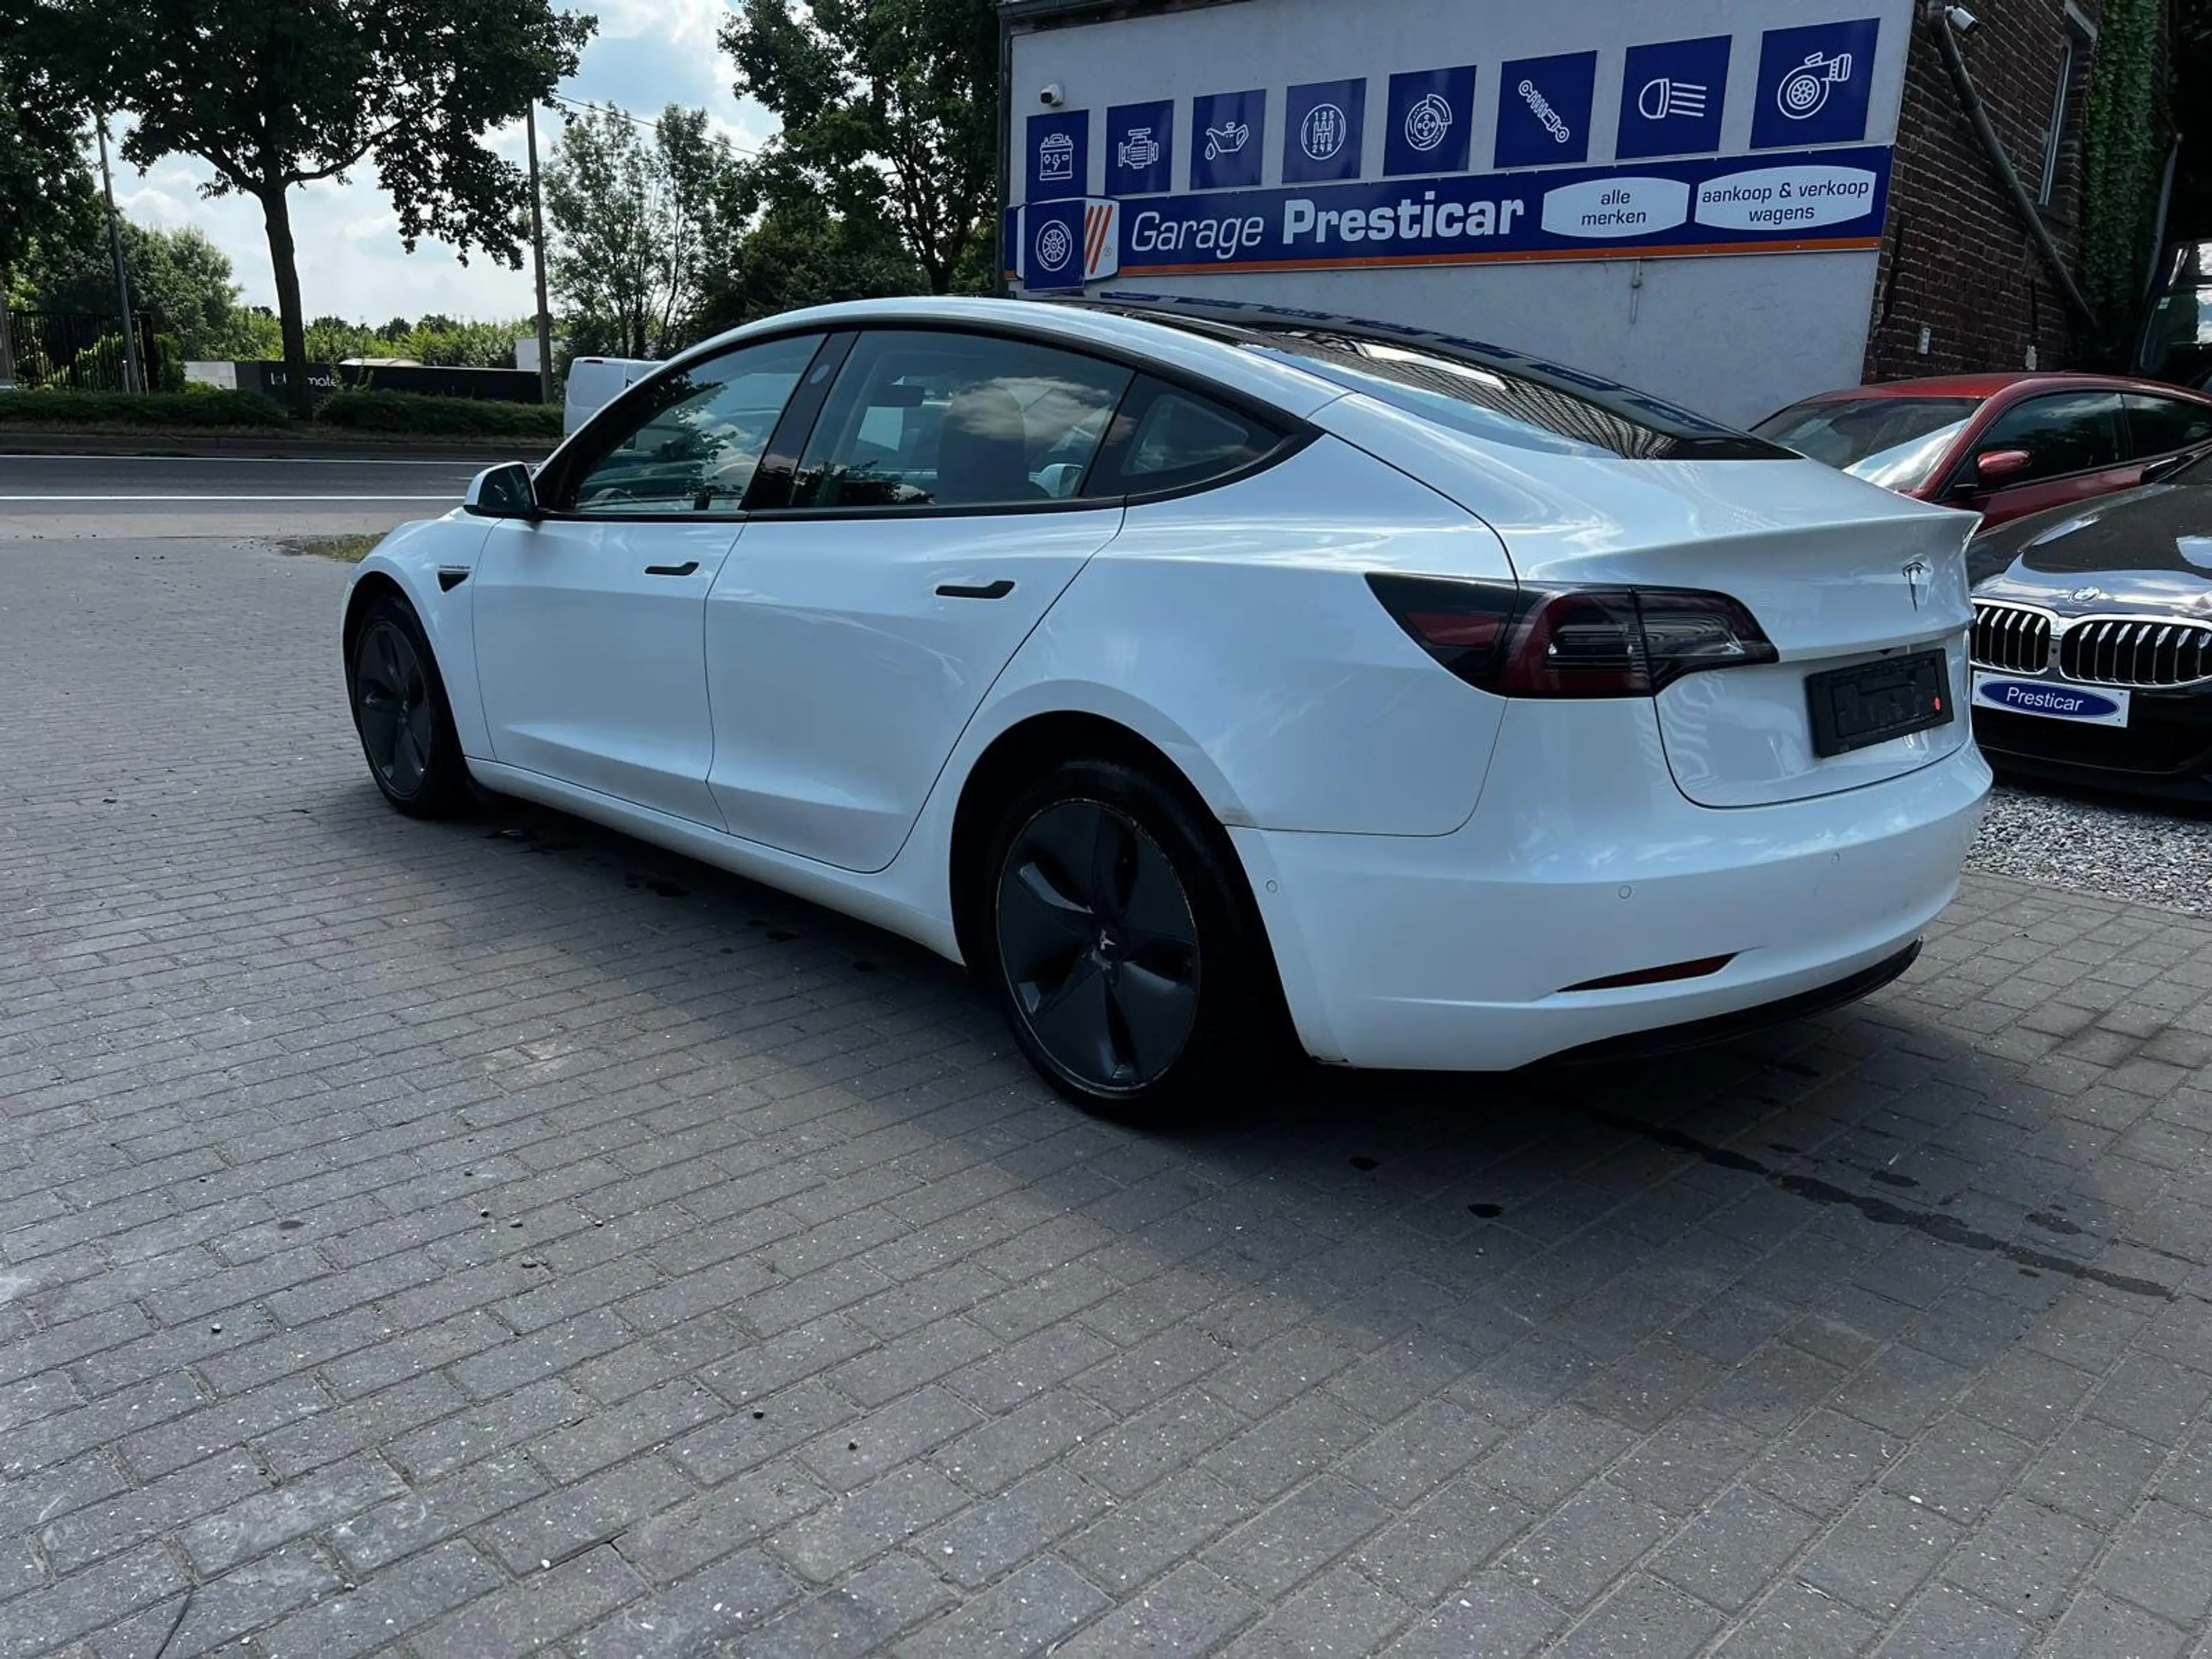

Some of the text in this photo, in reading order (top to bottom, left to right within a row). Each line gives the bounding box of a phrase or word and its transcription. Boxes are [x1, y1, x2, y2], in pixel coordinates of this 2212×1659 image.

[1601, 189, 1631, 205] alle
[1702, 179, 1869, 203] aankoop & verkoop
[1131, 191, 1525, 259] Garage Presticar
[1581, 209, 1646, 226] merken
[1749, 206, 1815, 225] wagens
[2006, 687, 2084, 711] Presticar
